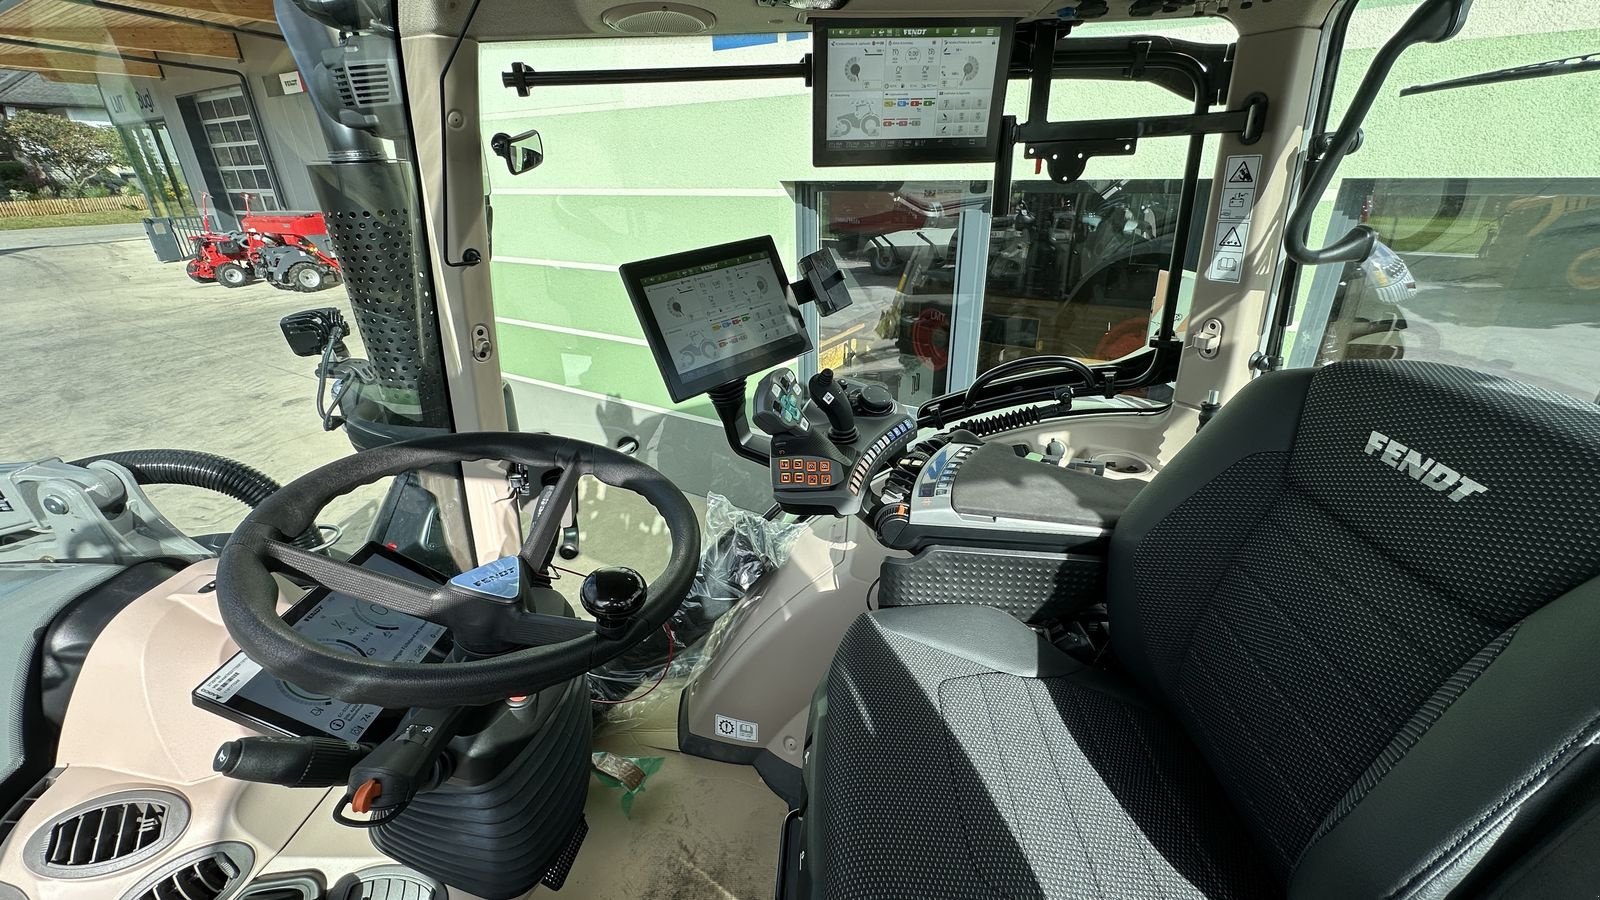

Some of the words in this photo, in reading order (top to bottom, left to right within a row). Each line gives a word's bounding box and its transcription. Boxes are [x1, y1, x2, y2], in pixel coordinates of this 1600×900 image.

[109, 95, 126, 113] LMT
[1364, 430, 1489, 502] FENDT
[473, 566, 514, 586] FENDT
